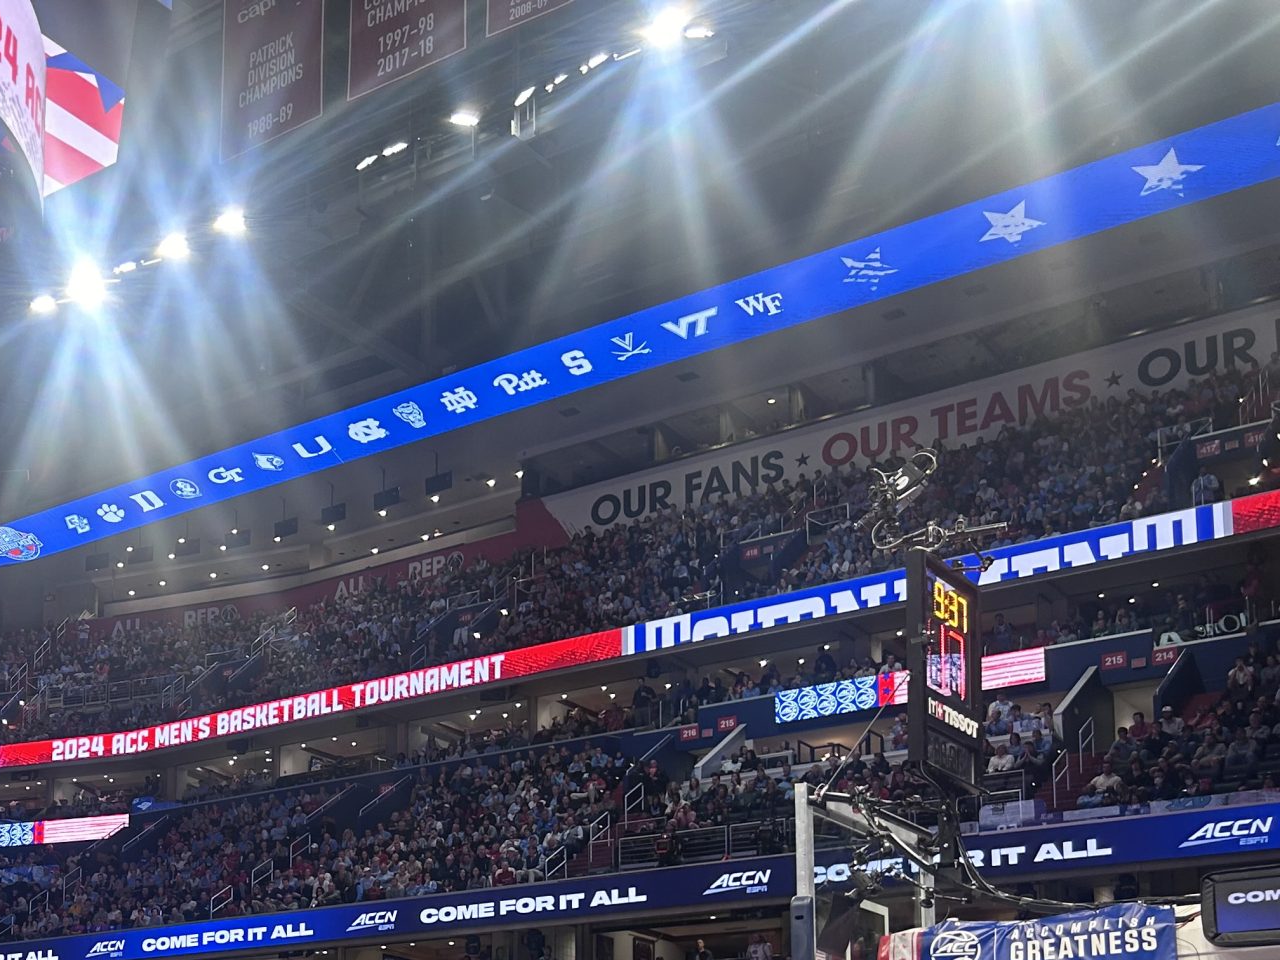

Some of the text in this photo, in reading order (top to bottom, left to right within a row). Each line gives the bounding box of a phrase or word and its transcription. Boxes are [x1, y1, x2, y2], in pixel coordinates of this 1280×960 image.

[378, 13, 434, 53] 1997-98
[249, 31, 294, 69] PATRICK
[377, 36, 434, 77] 2017-18
[248, 49, 295, 87] DIVISION
[239, 63, 303, 108] CHAMPIONS
[248, 103, 293, 139] 1988-89
[493, 369, 550, 396] Pitt
[560, 349, 593, 375] S
[660, 305, 718, 340] VT
[734, 292, 784, 317] WF
[590, 327, 1259, 527] OUR FANS OUR TEAMS OUR
[1104, 654, 1124, 666] 215
[1155, 650, 1174, 662] 214
[51, 654, 505, 762] 2024 ACC MEN'S BASKETBALL TOURNAMENT
[943, 704, 979, 739] TISSOT
[682, 727, 698, 739] 216
[719, 717, 735, 730] 215
[1187, 817, 1273, 841] ACCN
[1239, 836, 1269, 846] ESPN
[991, 846, 1026, 867] IT
[1033, 838, 1112, 863] ALL
[710, 868, 771, 892] ACCN
[419, 886, 647, 924] COME FOR IT ALL
[1227, 888, 1280, 905] COM
[354, 909, 398, 928] ACCN
[1010, 915, 1156, 940] ACCOMPLISH
[90, 939, 126, 954] ACCN
[142, 922, 314, 952] COME FOR IT ALL
[937, 941, 978, 955] ACC
